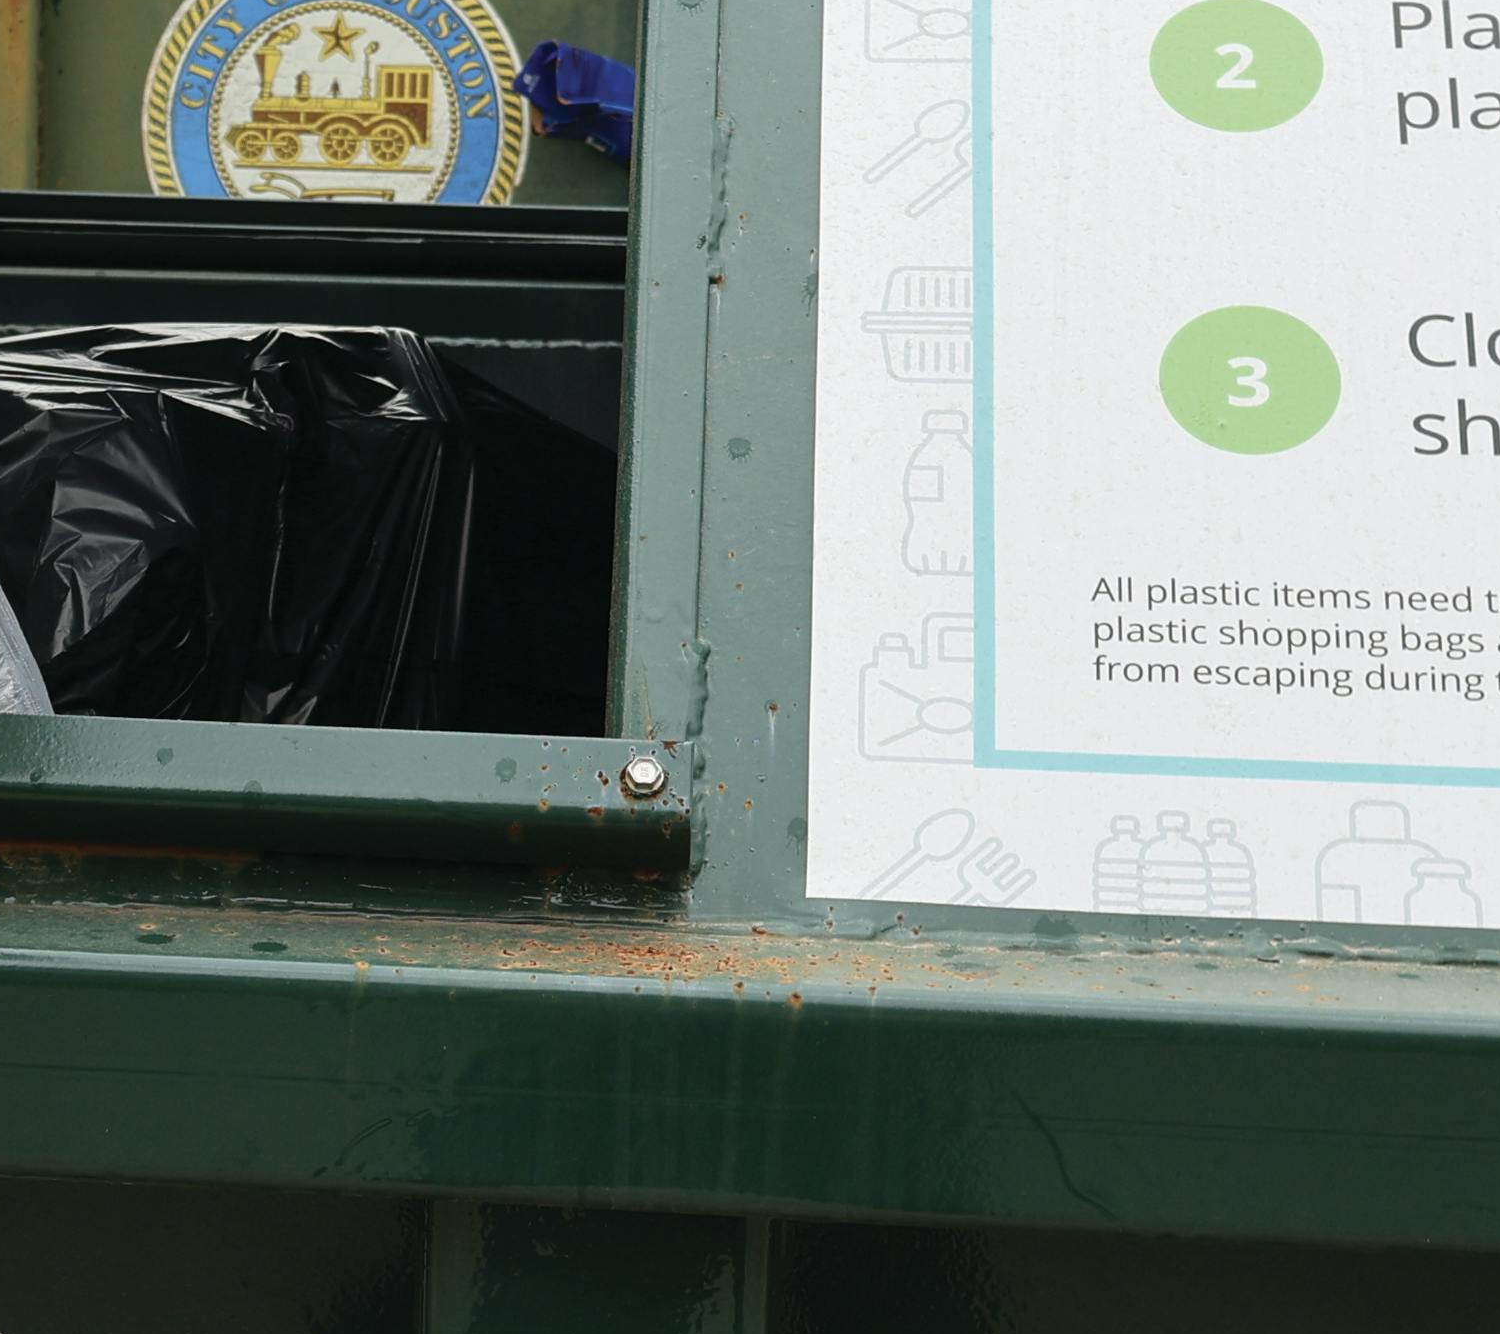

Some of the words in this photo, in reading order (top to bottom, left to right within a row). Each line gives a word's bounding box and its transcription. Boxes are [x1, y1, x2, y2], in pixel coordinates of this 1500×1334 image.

[178, 10, 248, 110] CITY
[1214, 43, 1258, 90] 2
[1226, 357, 1272, 408] 3
[1091, 576, 1133, 604] All
[1146, 578, 1260, 611] plastic
[1273, 582, 1372, 610] items
[1384, 586, 1473, 613] need
[1092, 617, 1208, 648] plastic
[1218, 618, 1388, 658] shopping
[1401, 623, 1484, 660] bags
[1092, 655, 1180, 684] from
[1193, 660, 1353, 697] escaping
[1364, 664, 1484, 701] during
